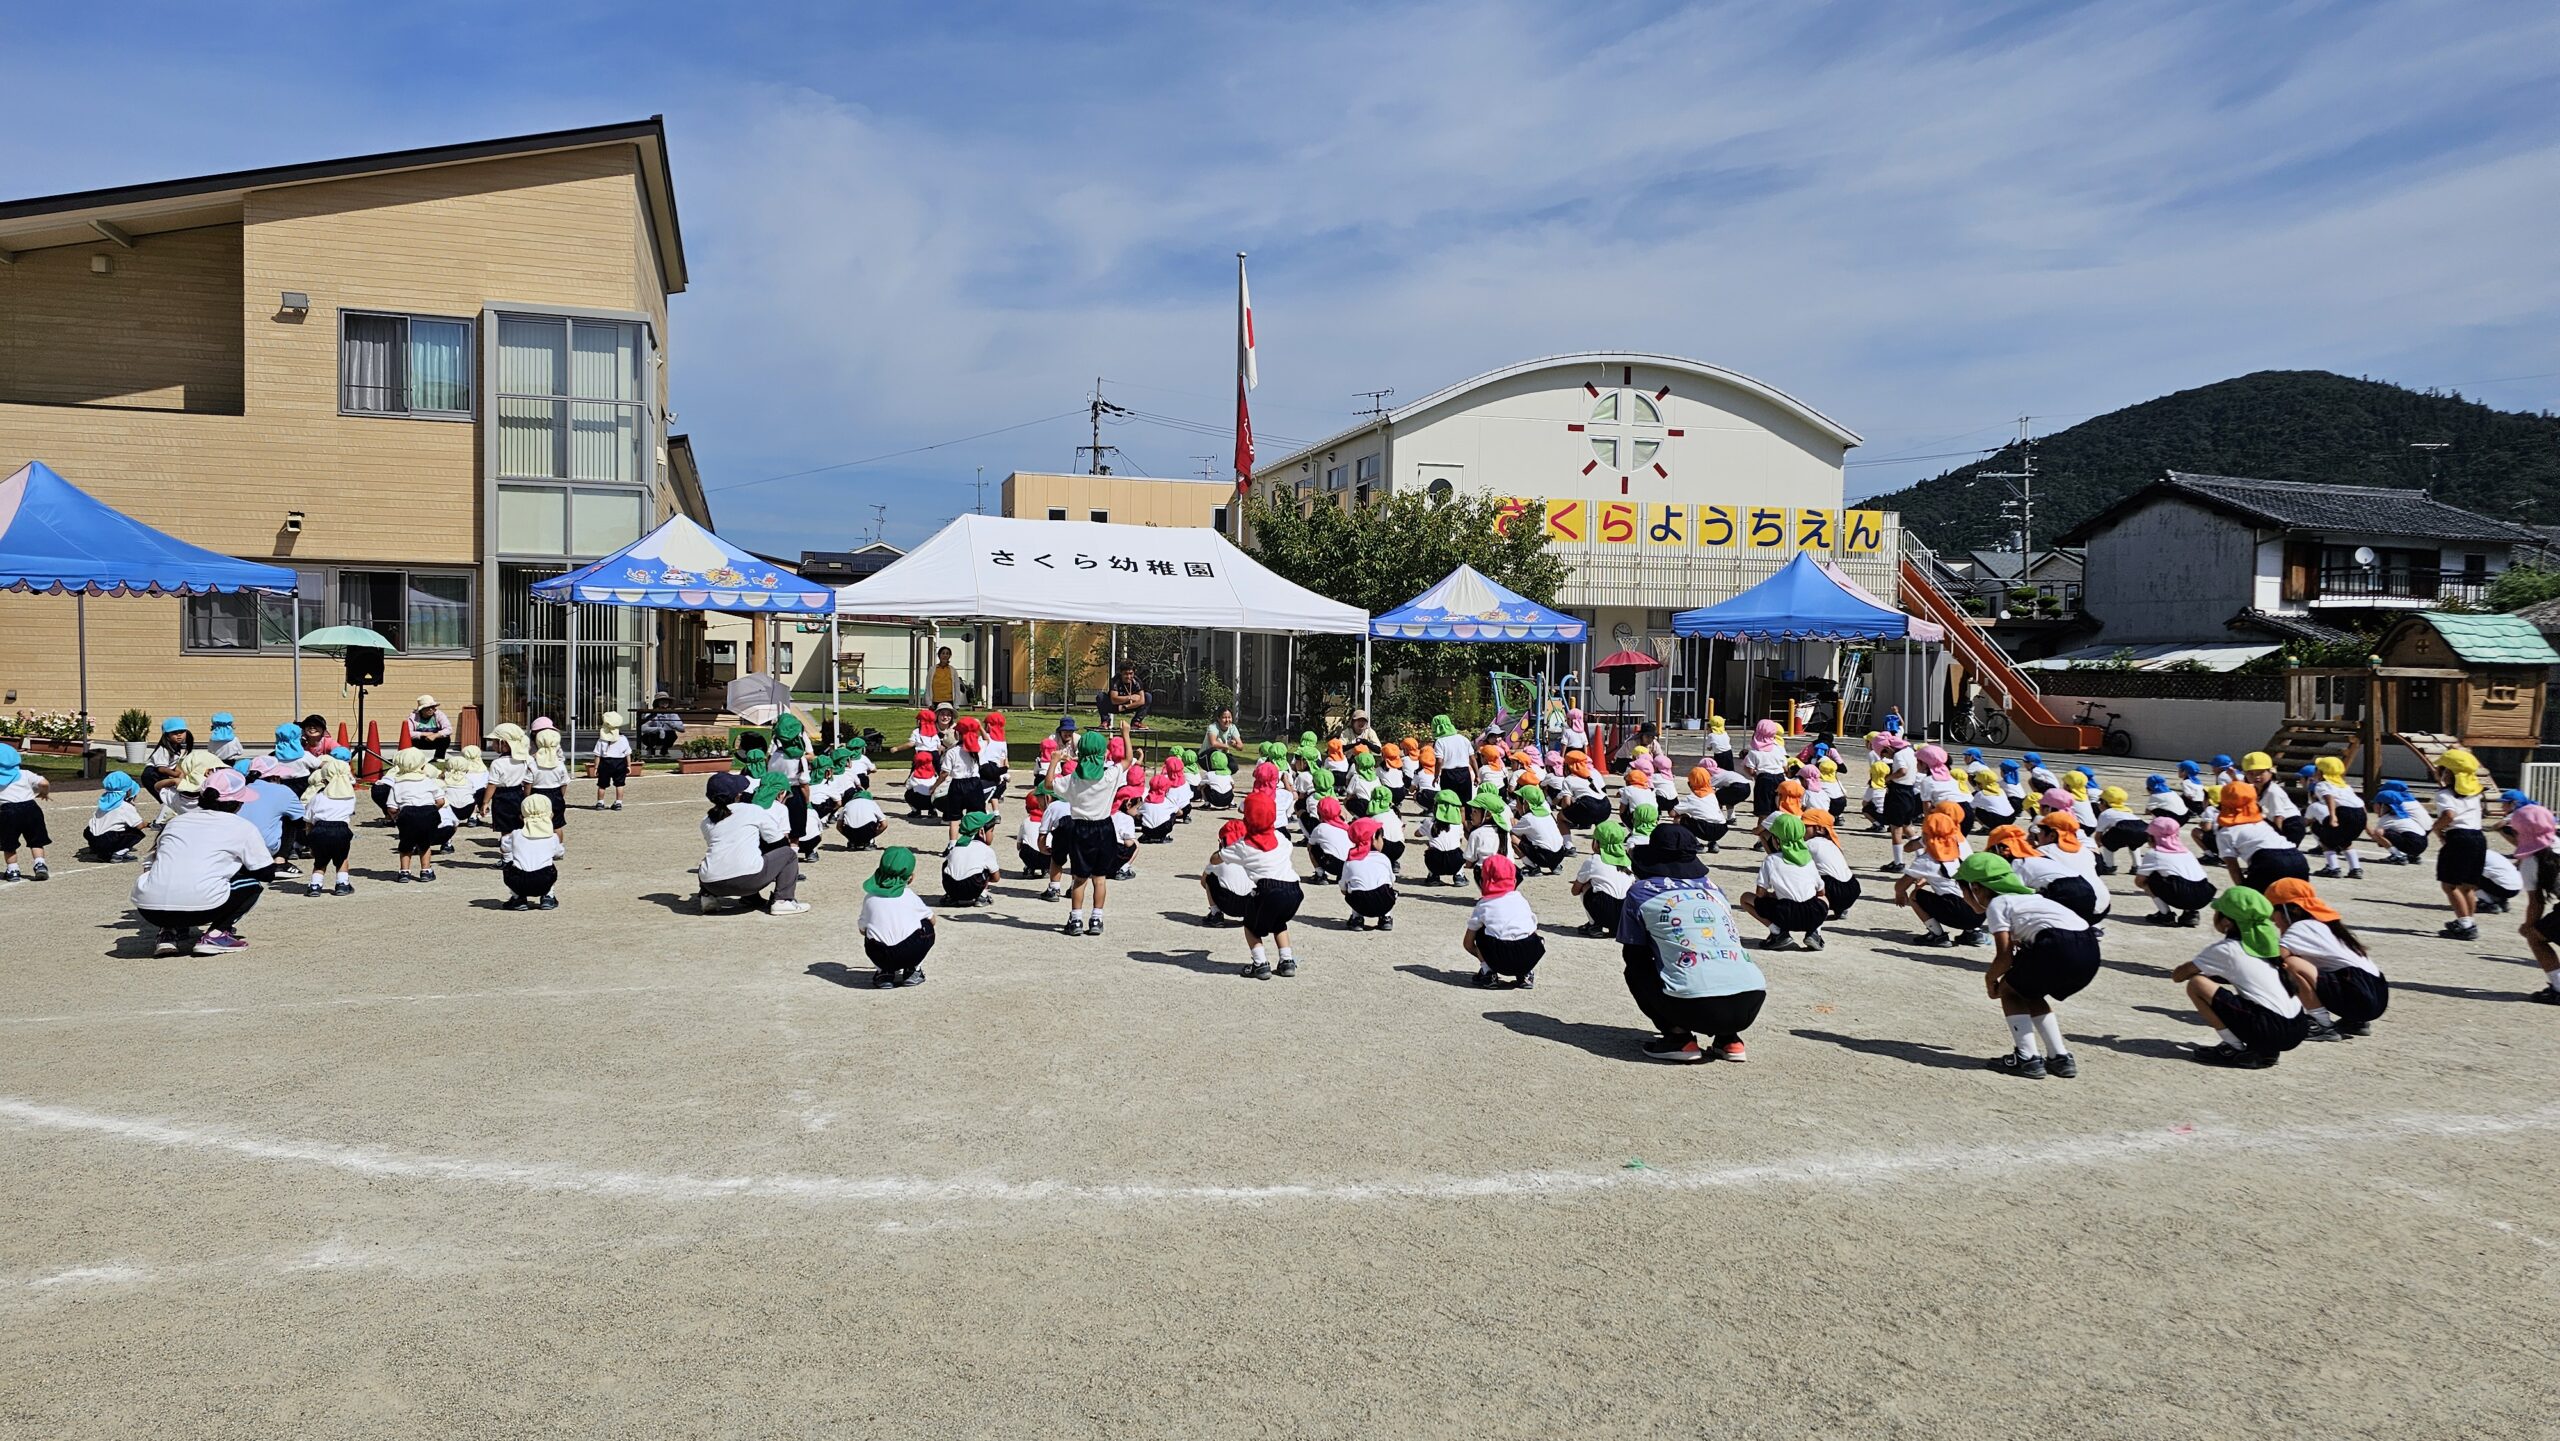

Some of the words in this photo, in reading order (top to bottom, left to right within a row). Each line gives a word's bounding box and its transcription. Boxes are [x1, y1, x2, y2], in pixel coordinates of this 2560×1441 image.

[1498, 497, 1881, 549] さくらようちえん
[991, 549, 1215, 578] さくら幼稚園
[1700, 949, 1738, 961] ALIEN
